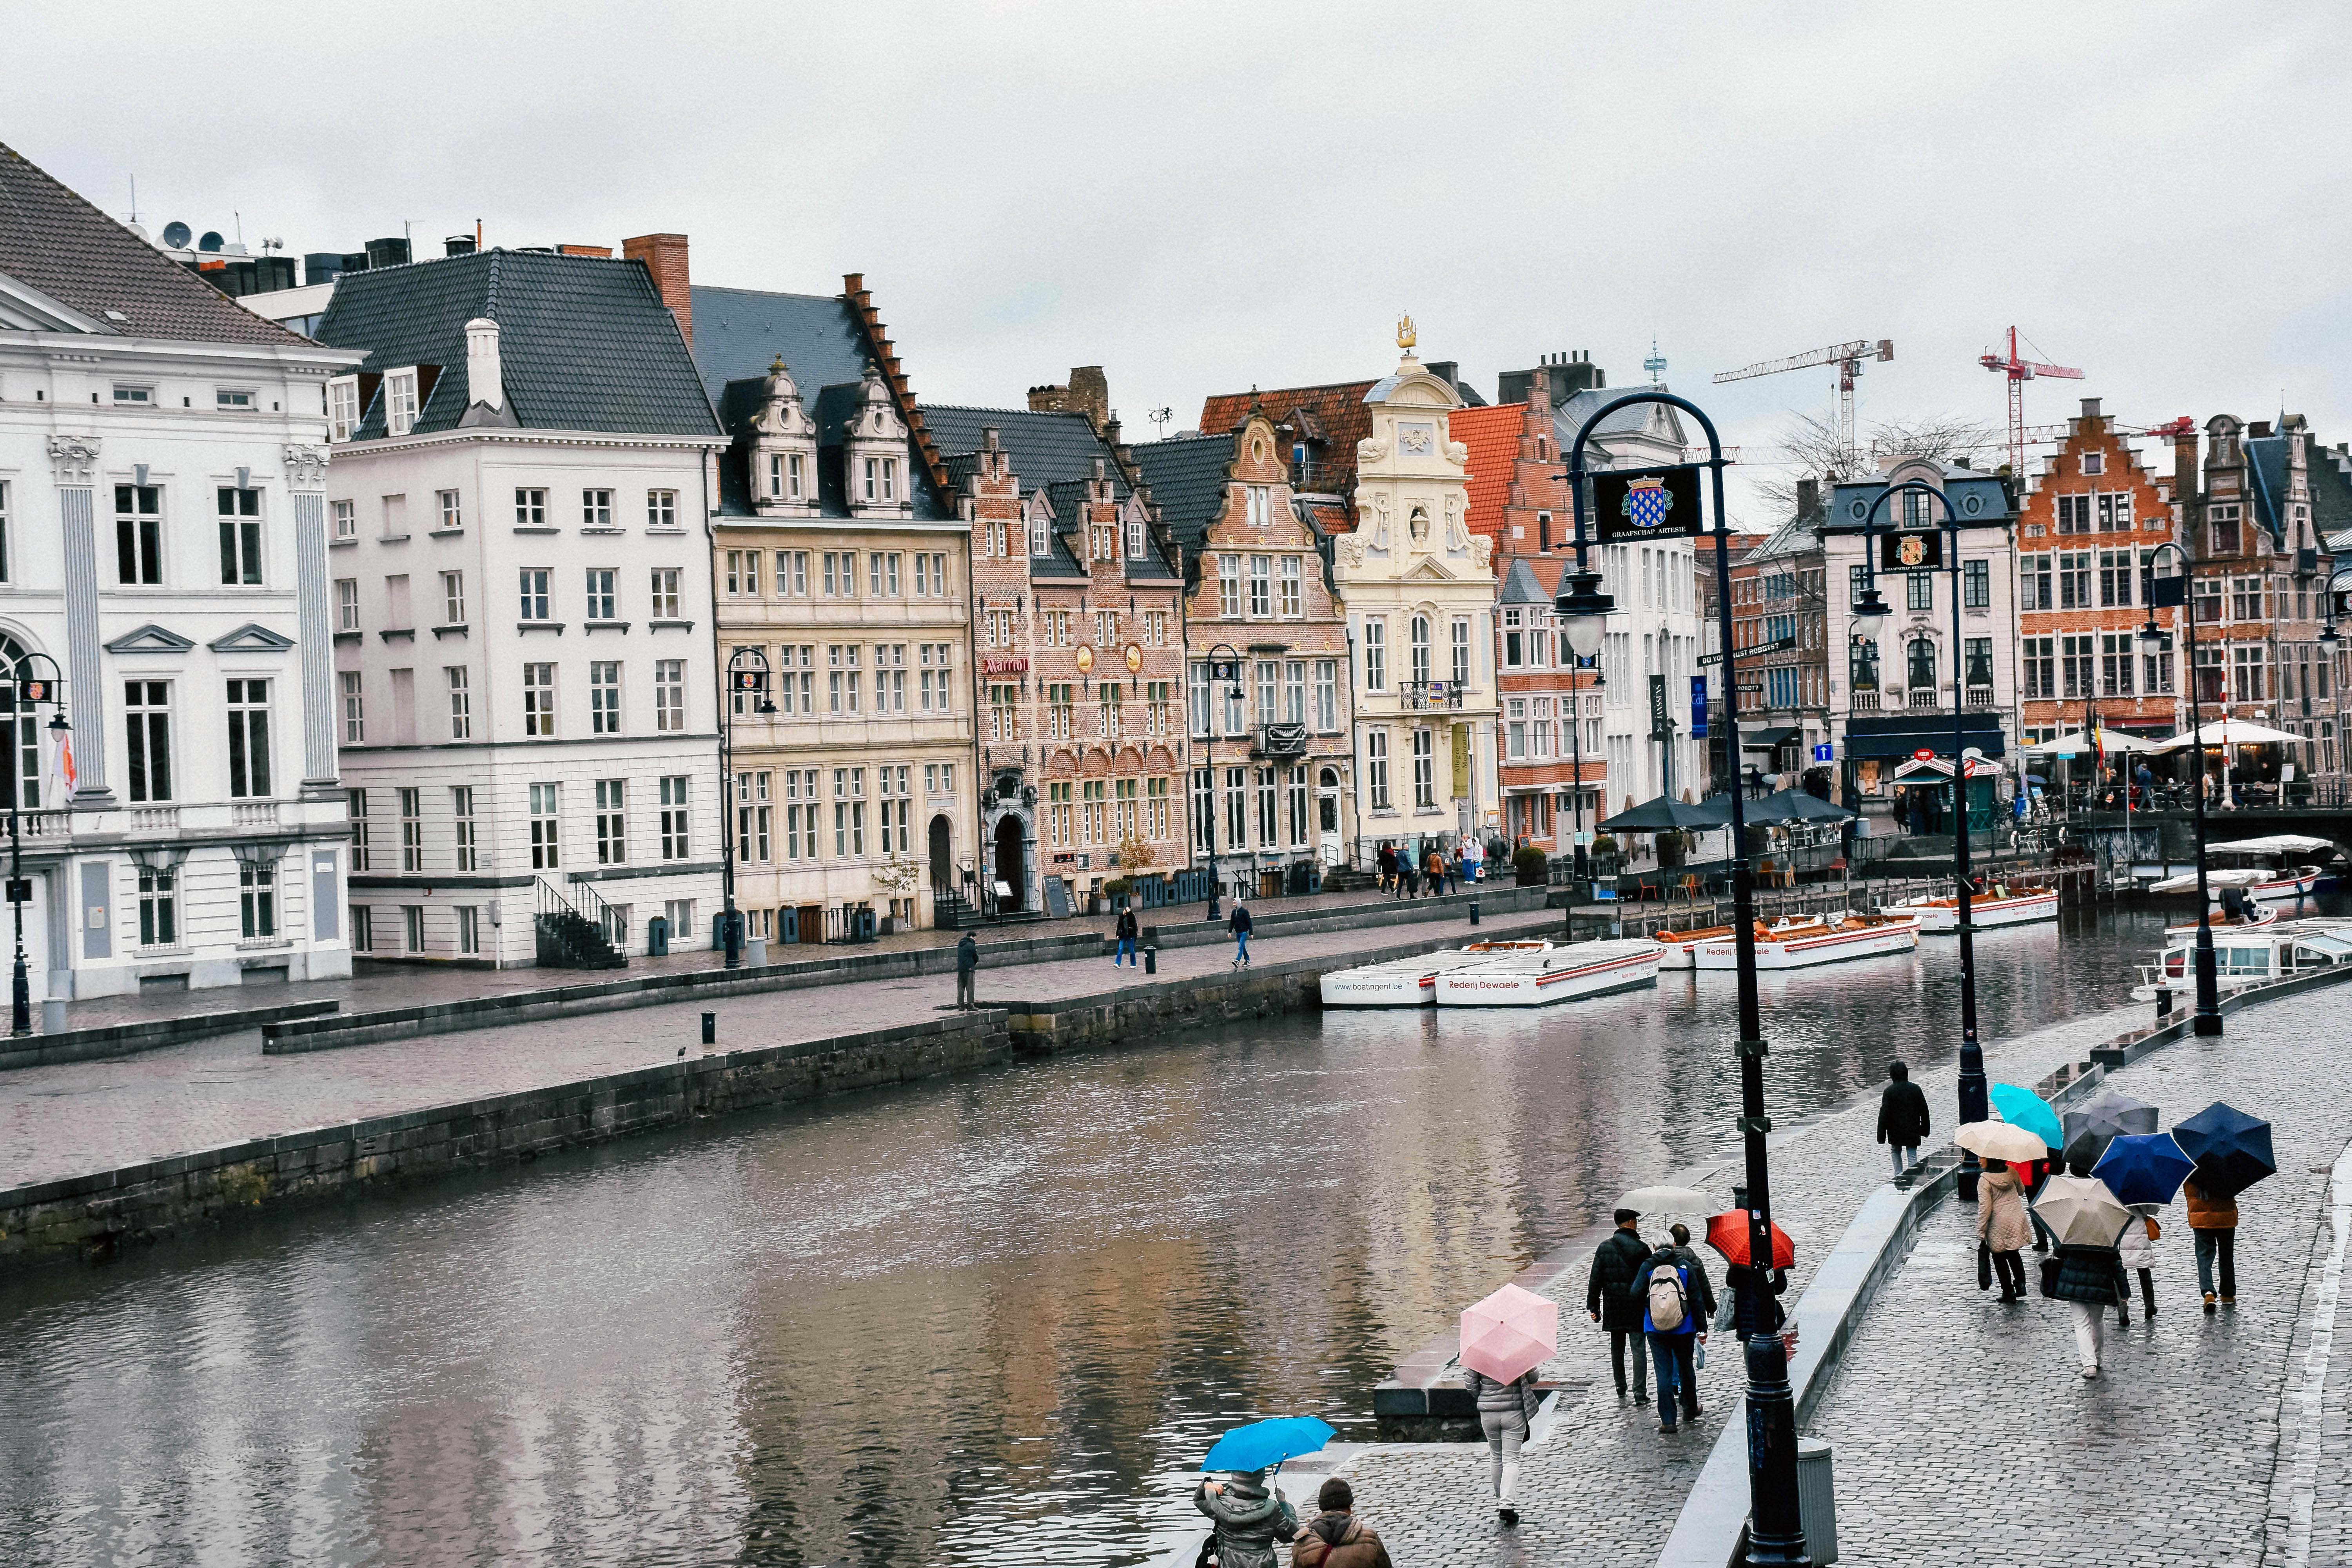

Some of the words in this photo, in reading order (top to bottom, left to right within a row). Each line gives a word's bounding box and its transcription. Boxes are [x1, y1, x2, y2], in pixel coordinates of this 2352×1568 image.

[1612, 529, 1655, 538] GRAAFSCHAP
[1749, 642, 1779, 654] ROBOTS?
[1691, 693, 1705, 705] CdF
[1900, 761, 1916, 772] TICKETS
[1929, 759, 1953, 772] BOOTTRIPS
[1707, 948, 1732, 956] Rederij
[1334, 982, 1403, 992] www.boatingent.be
[1449, 981, 1477, 991] Rederij
